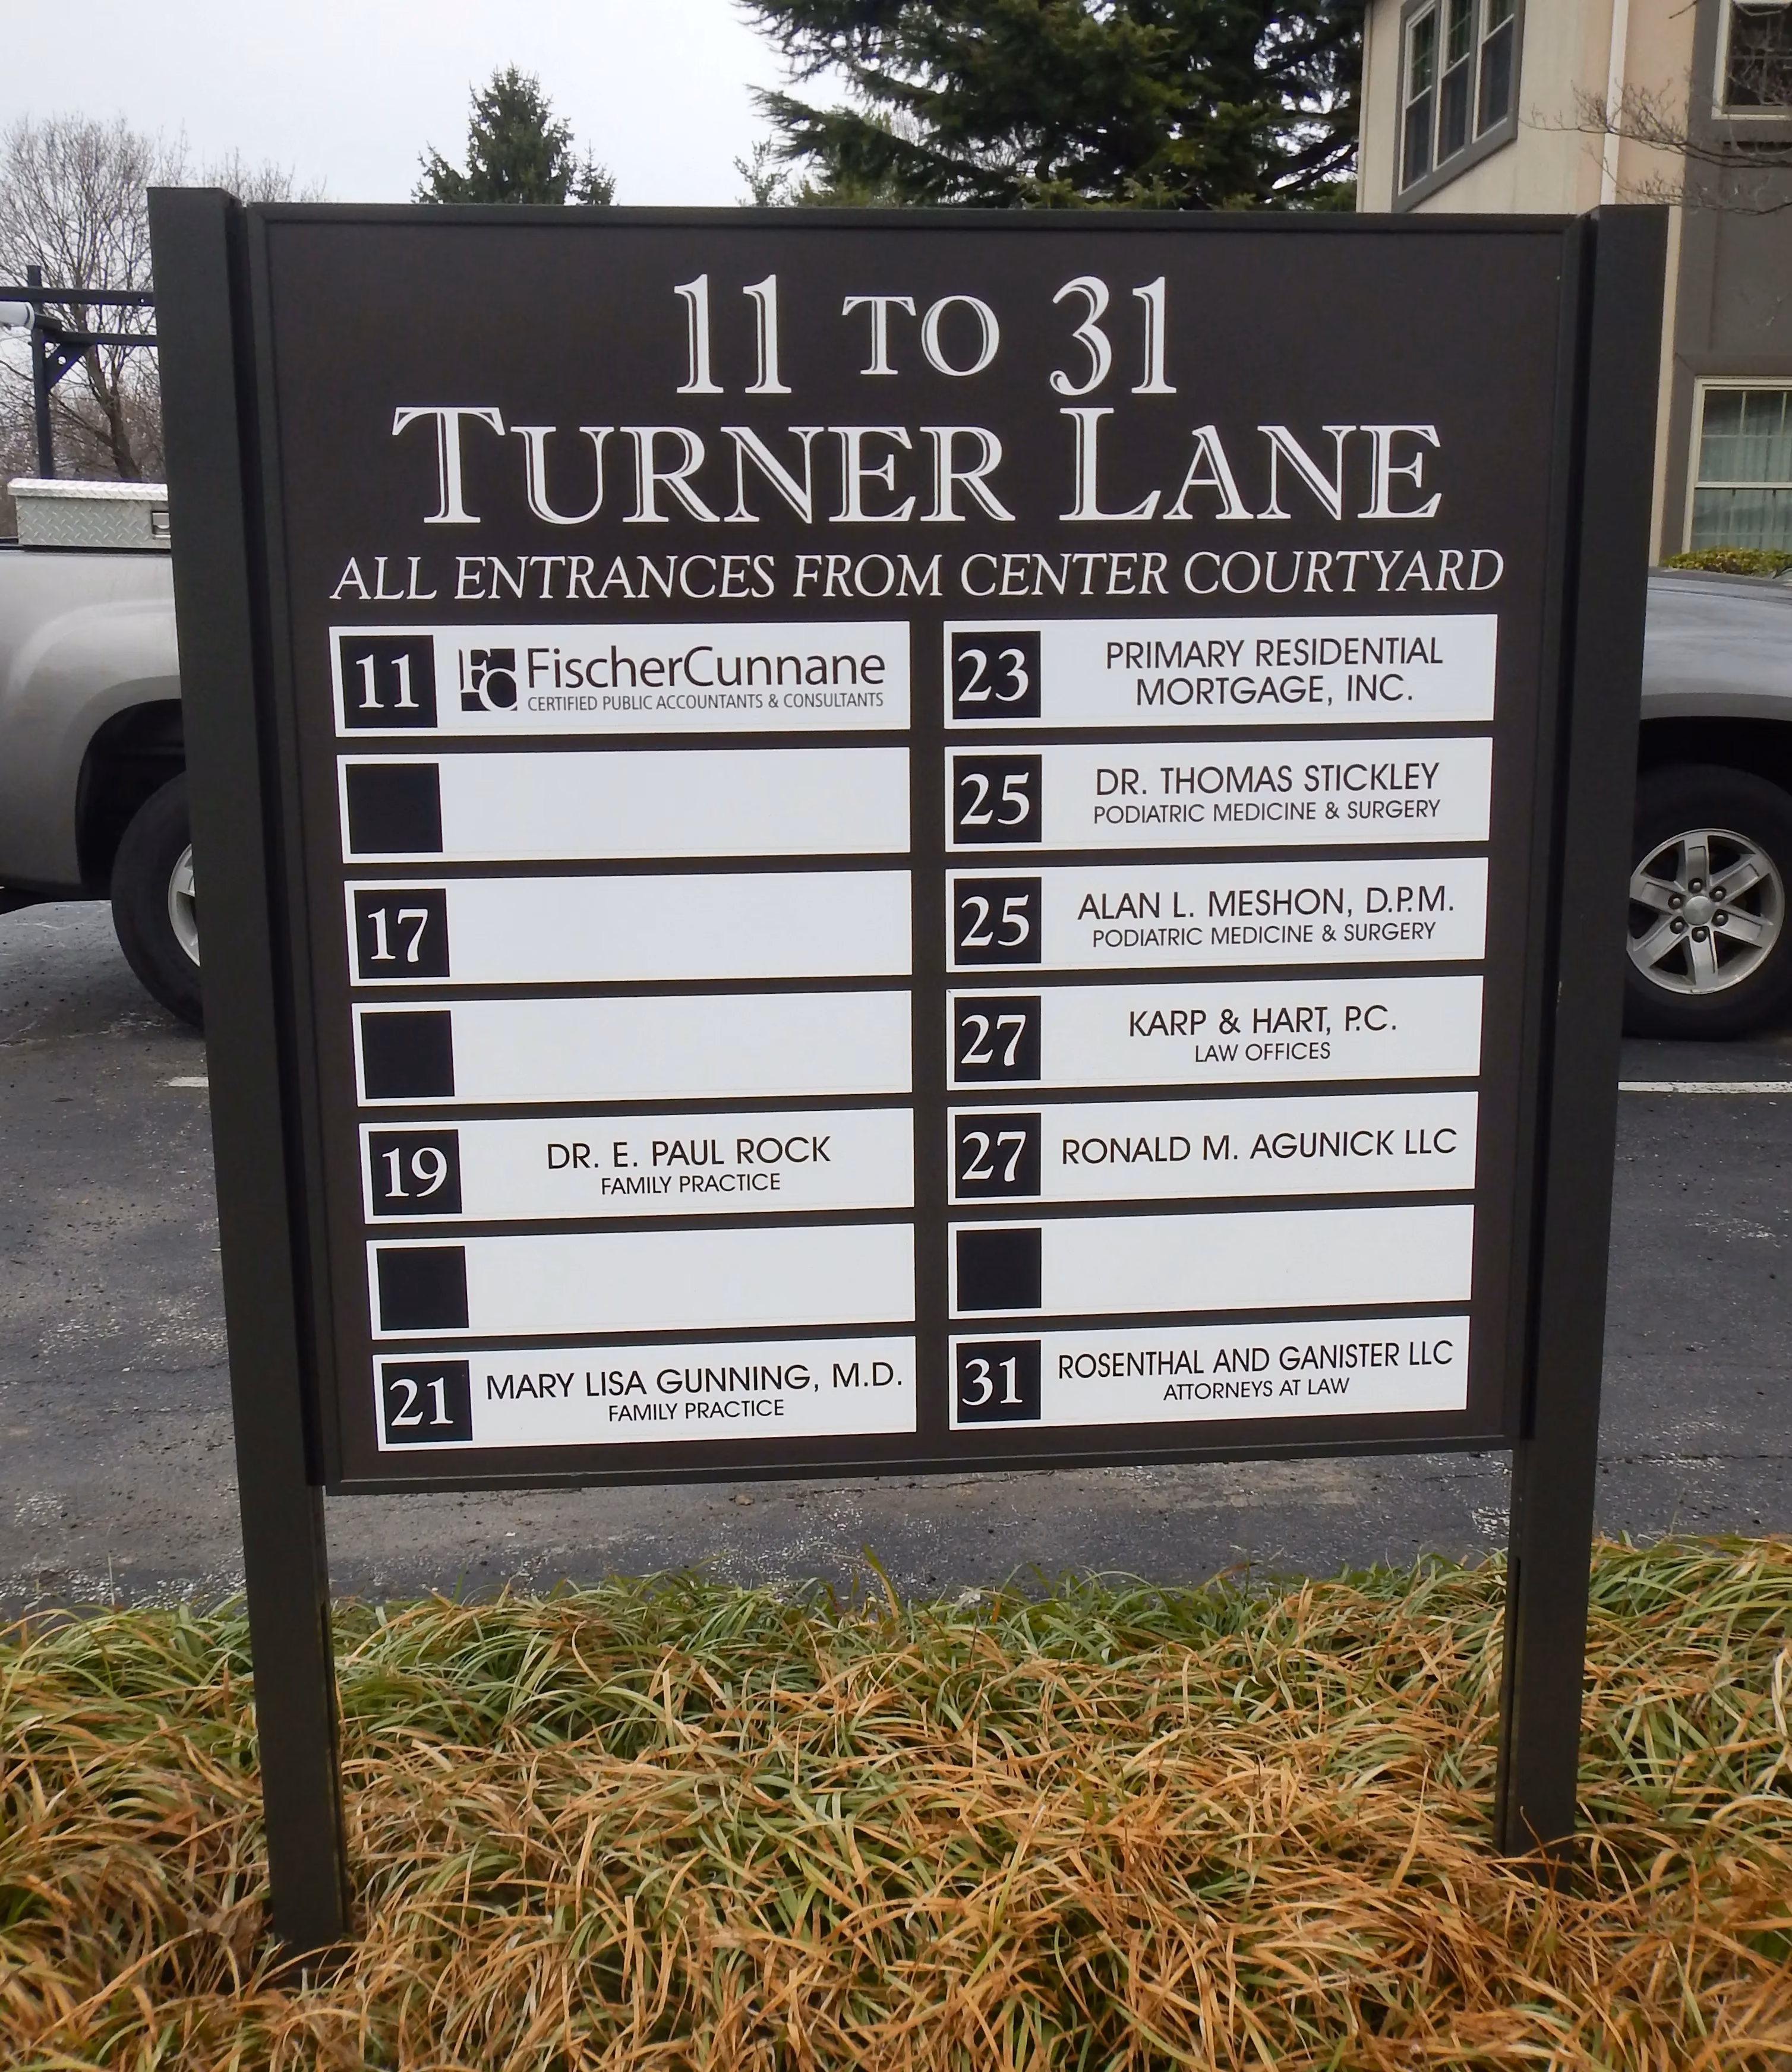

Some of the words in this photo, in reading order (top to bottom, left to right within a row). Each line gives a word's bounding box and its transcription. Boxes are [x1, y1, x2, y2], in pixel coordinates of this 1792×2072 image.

[674, 274, 791, 393] 11
[1050, 276, 1176, 395] 31
[330, 557, 437, 599] ALL
[455, 555, 774, 599] ENTRANCES
[793, 554, 942, 596] FROM
[961, 552, 1169, 596] CENTER
[1185, 549, 1503, 593] COURTYARD
[528, 646, 885, 688] FischerCunnane
[1108, 640, 1244, 669] PRIMARY
[1257, 637, 1443, 666] RESIDENTIAL
[356, 655, 419, 707] 11
[958, 649, 1028, 701] 23
[1137, 675, 1332, 706] MORTGAGE,
[1348, 674, 1412, 701] INC.
[528, 697, 597, 710] CERTIFIED
[604, 696, 652, 710] PUBLIC
[657, 694, 762, 709] ACCOUNTANTS
[769, 694, 778, 707] &
[784, 693, 882, 707] CONSULTANTS
[1097, 769, 1146, 795] DR.
[1160, 766, 1292, 794] THOMAS
[1305, 763, 1439, 791] STICKLEY
[961, 772, 1029, 825] 25
[1094, 804, 1204, 823] PODIATRIC
[1214, 803, 1315, 821] MEDICINE
[1326, 802, 1339, 819] &
[1348, 800, 1440, 819] SURGERY
[961, 895, 1029, 946] 25
[1078, 892, 1159, 920] ALAN
[1174, 892, 1193, 917] L.
[1209, 888, 1351, 917] MESHON,
[1367, 886, 1453, 913] D.P.M.
[368, 908, 428, 962] 17
[1094, 928, 1202, 947] PODIATRIC
[1212, 926, 1313, 945] MEDICINE
[1323, 925, 1336, 942] &
[1345, 922, 1436, 941] SURGERY
[1130, 1010, 1206, 1037] KARP
[1219, 1009, 1241, 1034] &
[1254, 1007, 1330, 1035] HART,
[1346, 1005, 1396, 1031] P.C.
[961, 1015, 1026, 1066] 27
[1196, 1044, 1238, 1062] LAW
[1245, 1042, 1330, 1061] OFFICES
[548, 1144, 598, 1169] DR.
[614, 1142, 637, 1167] E.
[652, 1140, 724, 1166] PAUL
[737, 1136, 830, 1164] ROCK
[962, 1132, 1026, 1182] 27
[1063, 1136, 1190, 1164] RONALD
[1204, 1135, 1237, 1160] M.
[1250, 1130, 1394, 1159] AGUNICK
[1406, 1129, 1456, 1154] LLC
[383, 1148, 447, 1197] 19
[602, 1176, 671, 1195] FAMILY
[680, 1173, 780, 1192] PRACTICE
[1059, 1350, 1204, 1379] ROSENTHAL
[1213, 1348, 1269, 1373] AND
[1280, 1343, 1399, 1370] GANISTER
[1410, 1340, 1453, 1365] LLC
[487, 1373, 574, 1400] MARY
[586, 1371, 646, 1396] LISA
[657, 1365, 818, 1394] GUNNING,
[834, 1362, 901, 1387] M.D.
[963, 1357, 1023, 1405] 31
[1163, 1381, 1272, 1400] ATTORNEYS
[1279, 1379, 1301, 1396] AT
[1308, 1378, 1349, 1395] LAW
[390, 1378, 453, 1426] 21
[610, 1403, 677, 1422] FAMILY
[686, 1400, 784, 1419] PRACTICE
